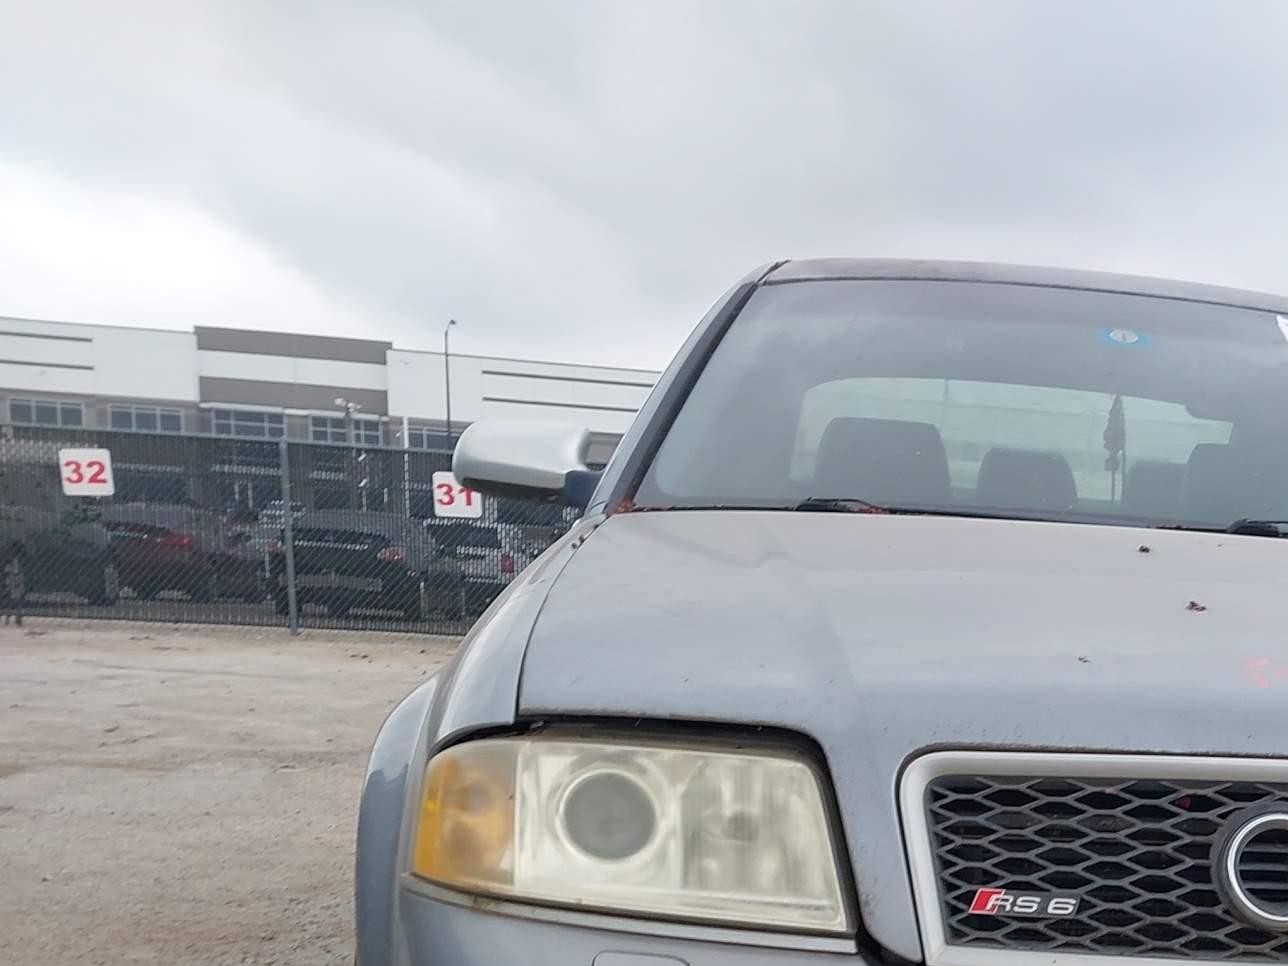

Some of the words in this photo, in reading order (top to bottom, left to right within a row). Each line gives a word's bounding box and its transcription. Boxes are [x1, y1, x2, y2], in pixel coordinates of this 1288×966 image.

[65, 463, 107, 484] 32
[437, 484, 473, 506] 31
[985, 894, 1042, 914] RS
[1046, 897, 1078, 915] 6
